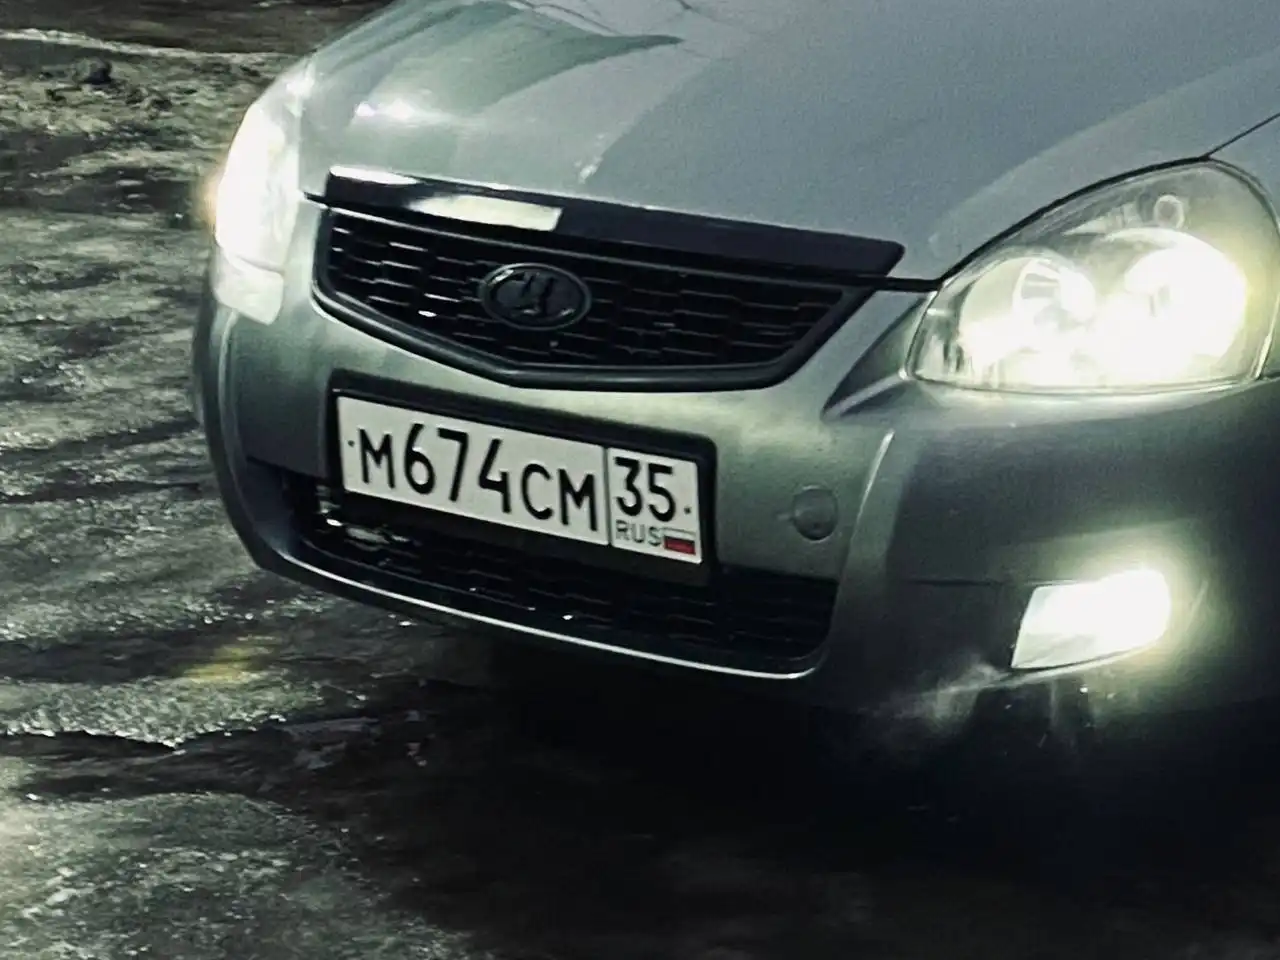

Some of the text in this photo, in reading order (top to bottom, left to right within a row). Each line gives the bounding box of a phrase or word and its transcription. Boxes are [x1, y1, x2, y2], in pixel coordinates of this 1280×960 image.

[358, 424, 676, 531] М674СМ 35
[615, 519, 662, 546] RUS
